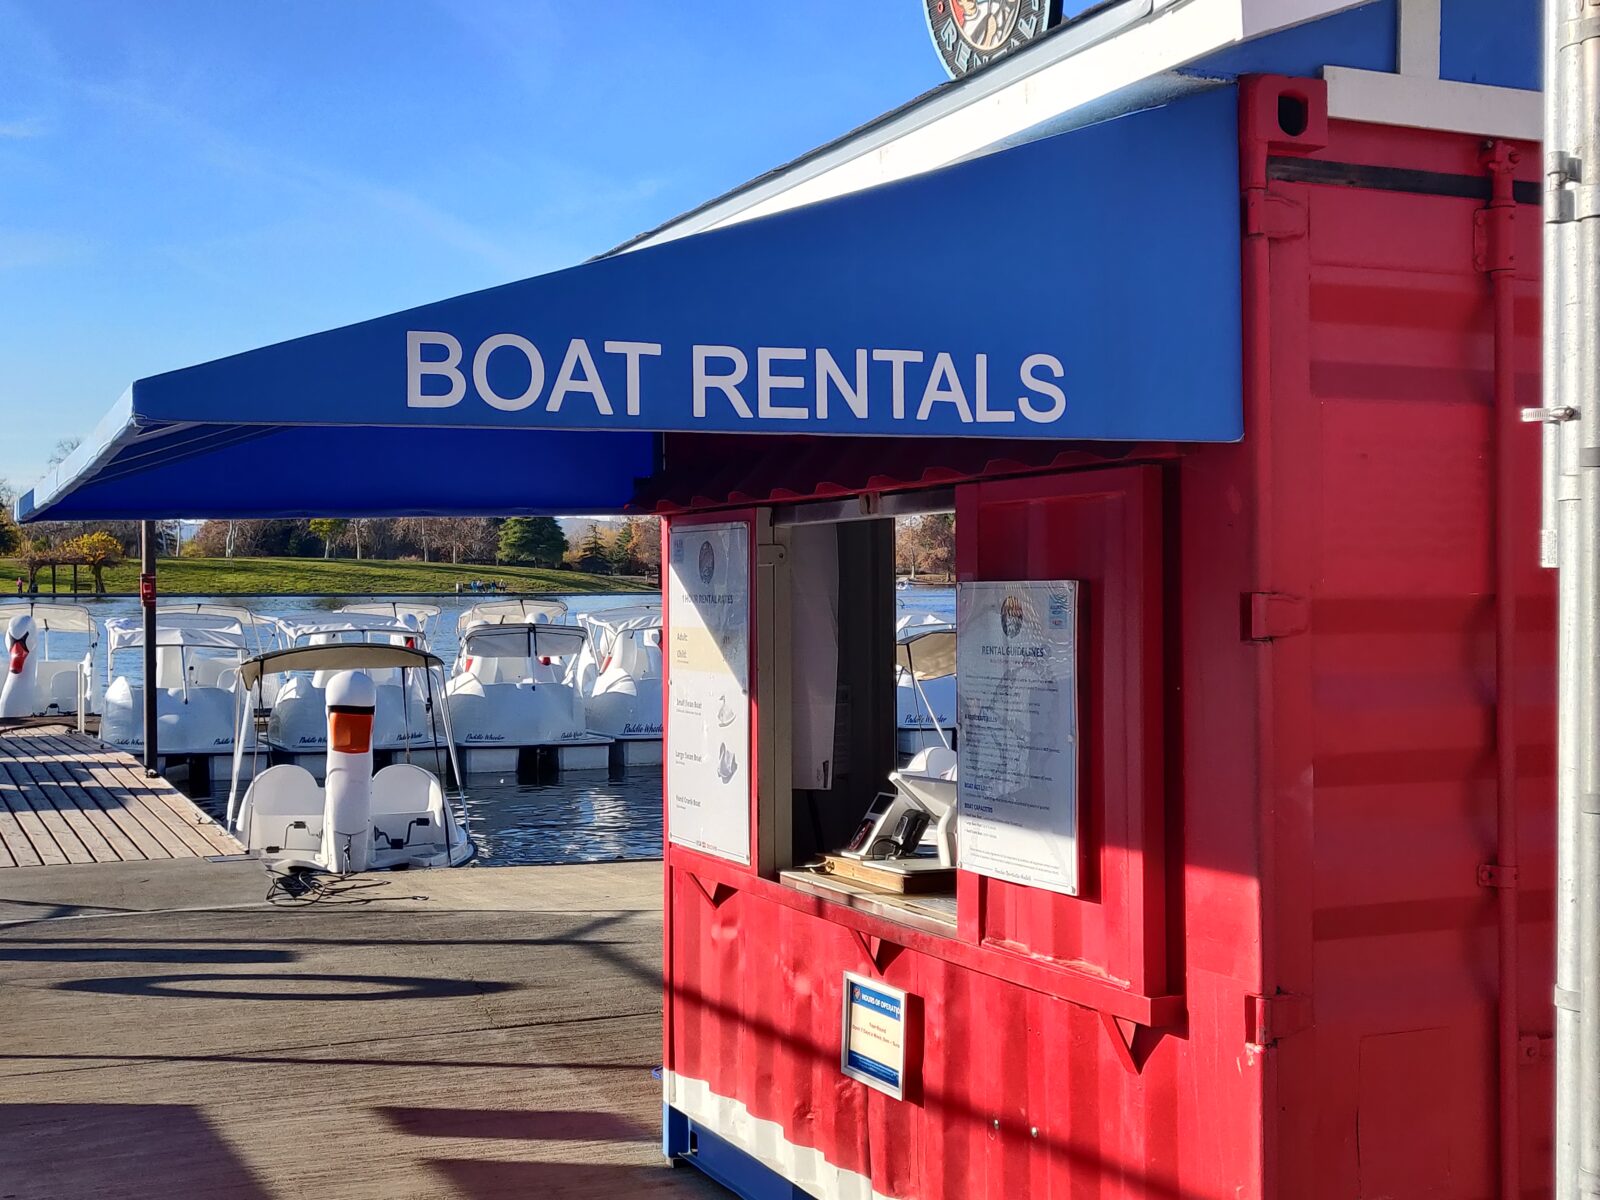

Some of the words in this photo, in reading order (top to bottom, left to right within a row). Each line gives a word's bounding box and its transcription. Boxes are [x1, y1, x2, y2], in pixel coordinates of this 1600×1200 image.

[407, 330, 661, 415] BOAT
[692, 344, 1066, 423] RENTALS
[981, 646, 1005, 656] RENTAL
[1005, 646, 1043, 657] GUIDELINES
